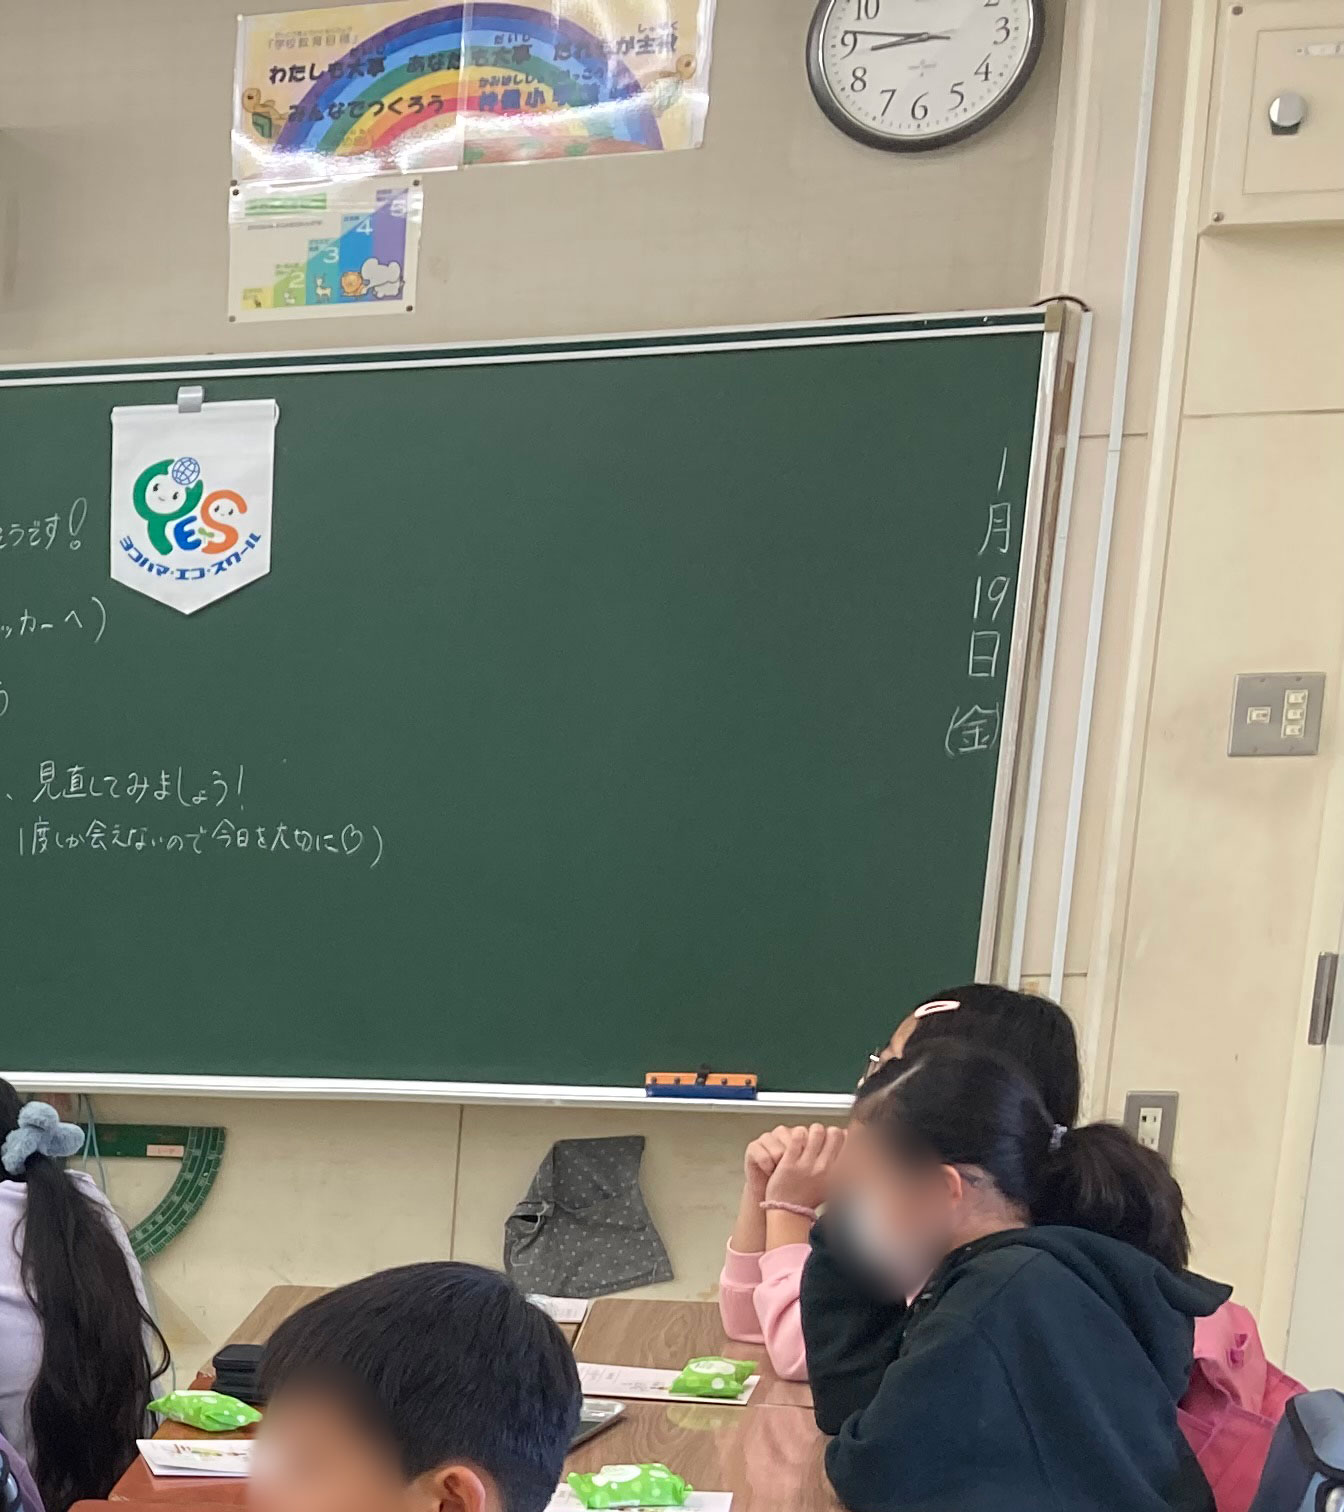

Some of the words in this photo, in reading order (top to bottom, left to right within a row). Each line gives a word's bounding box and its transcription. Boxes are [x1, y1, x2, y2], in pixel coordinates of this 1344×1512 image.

[993, 16, 1011, 45] 3
[840, 31, 858, 60] 9
[850, 66, 868, 93] 8
[974, 53, 992, 82] 4
[288, 95, 444, 124] みんなでつくろう
[880, 89, 897, 117] 7
[911, 92, 928, 120] 6
[948, 81, 965, 111] 5
[356, 221, 373, 236] 4
[323, 247, 340, 263] 3
[289, 272, 305, 288] 2
[133, 458, 248, 556] YES
